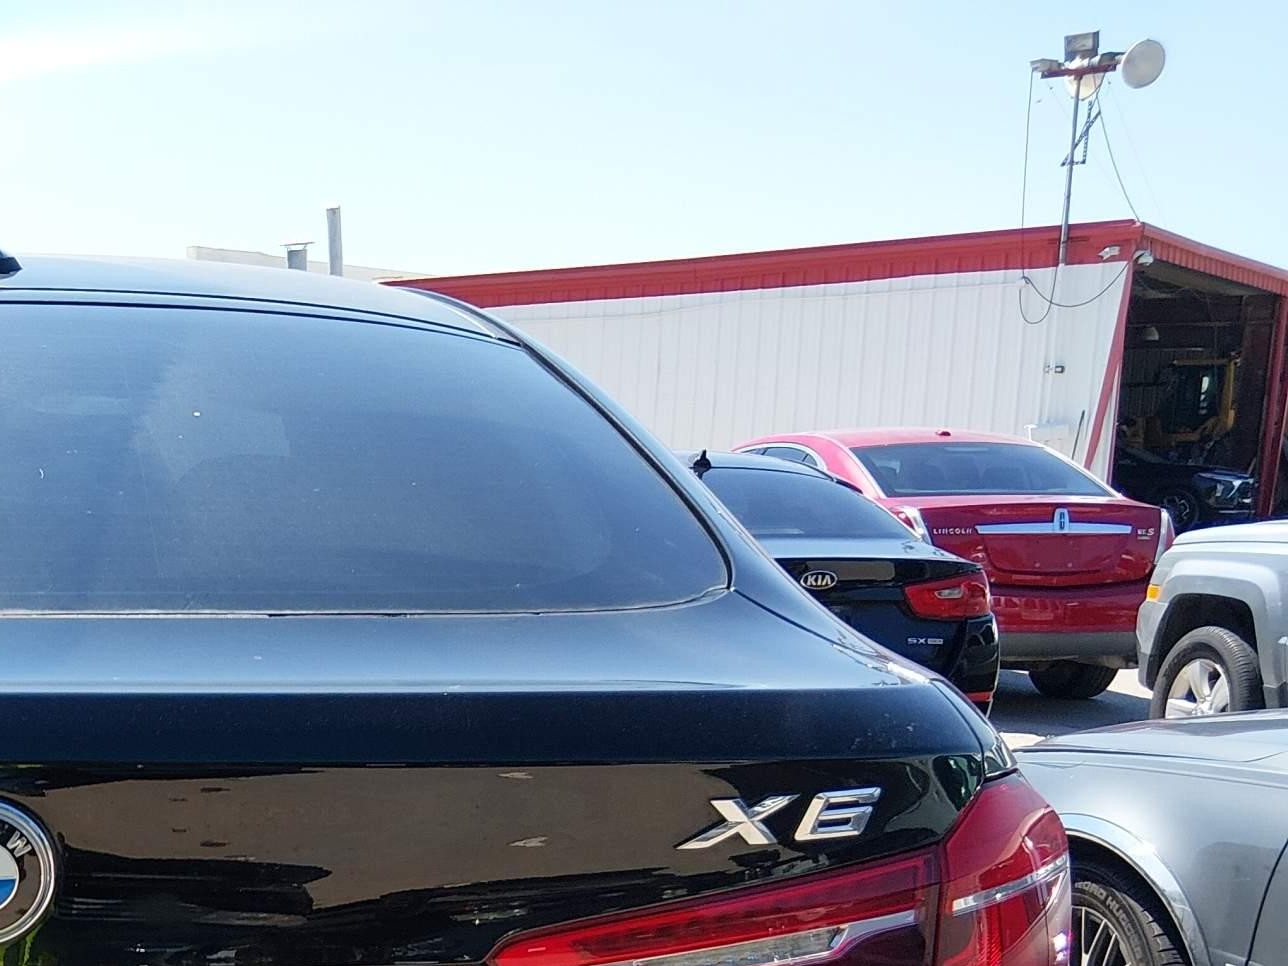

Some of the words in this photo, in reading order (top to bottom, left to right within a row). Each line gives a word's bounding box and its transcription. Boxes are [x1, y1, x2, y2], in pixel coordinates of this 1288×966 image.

[932, 527, 973, 536] LINCOLN
[806, 574, 832, 587] KIA
[907, 637, 926, 645] SX
[676, 786, 881, 850] X6
